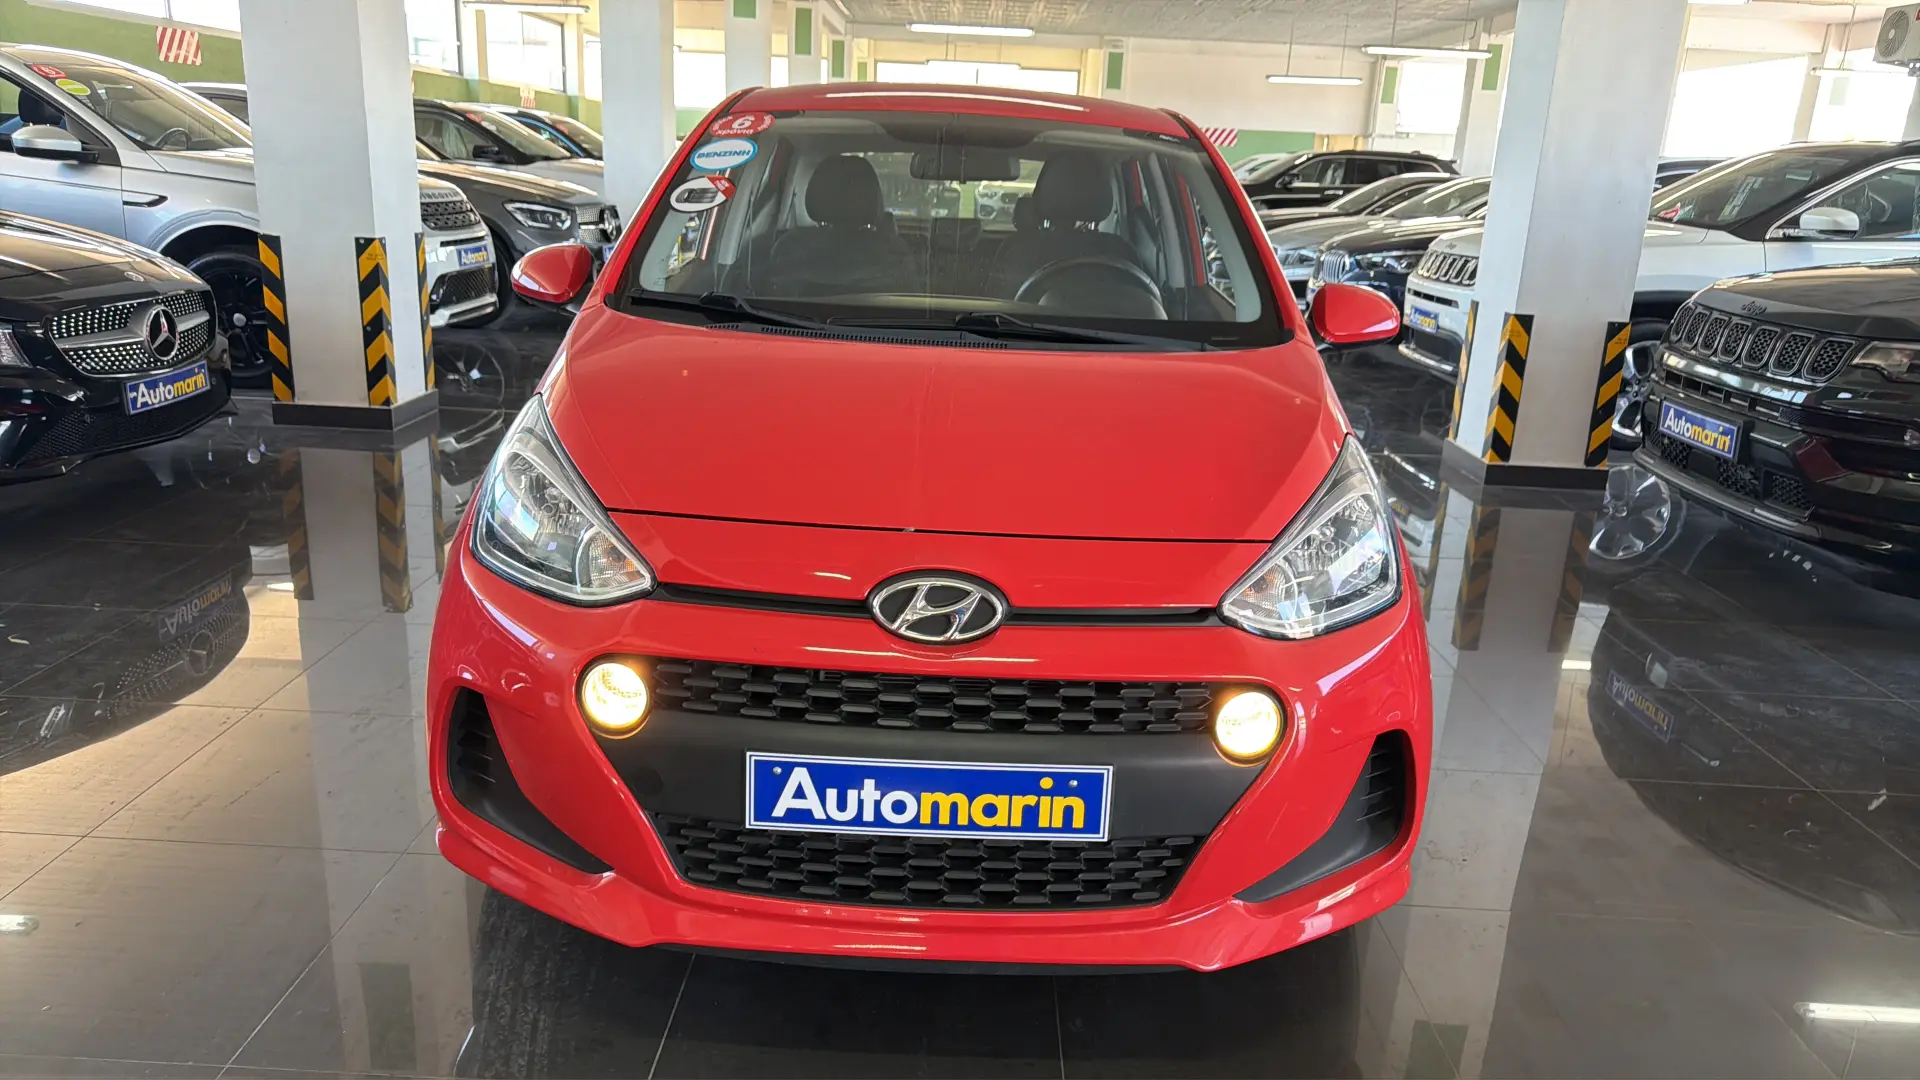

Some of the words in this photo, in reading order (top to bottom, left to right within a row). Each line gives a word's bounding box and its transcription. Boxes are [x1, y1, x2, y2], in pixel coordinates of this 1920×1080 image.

[731, 115, 755, 129] 6
[136, 367, 206, 408] Automarin
[1664, 407, 1731, 452] Automarin
[771, 766, 1085, 829] Automarin
